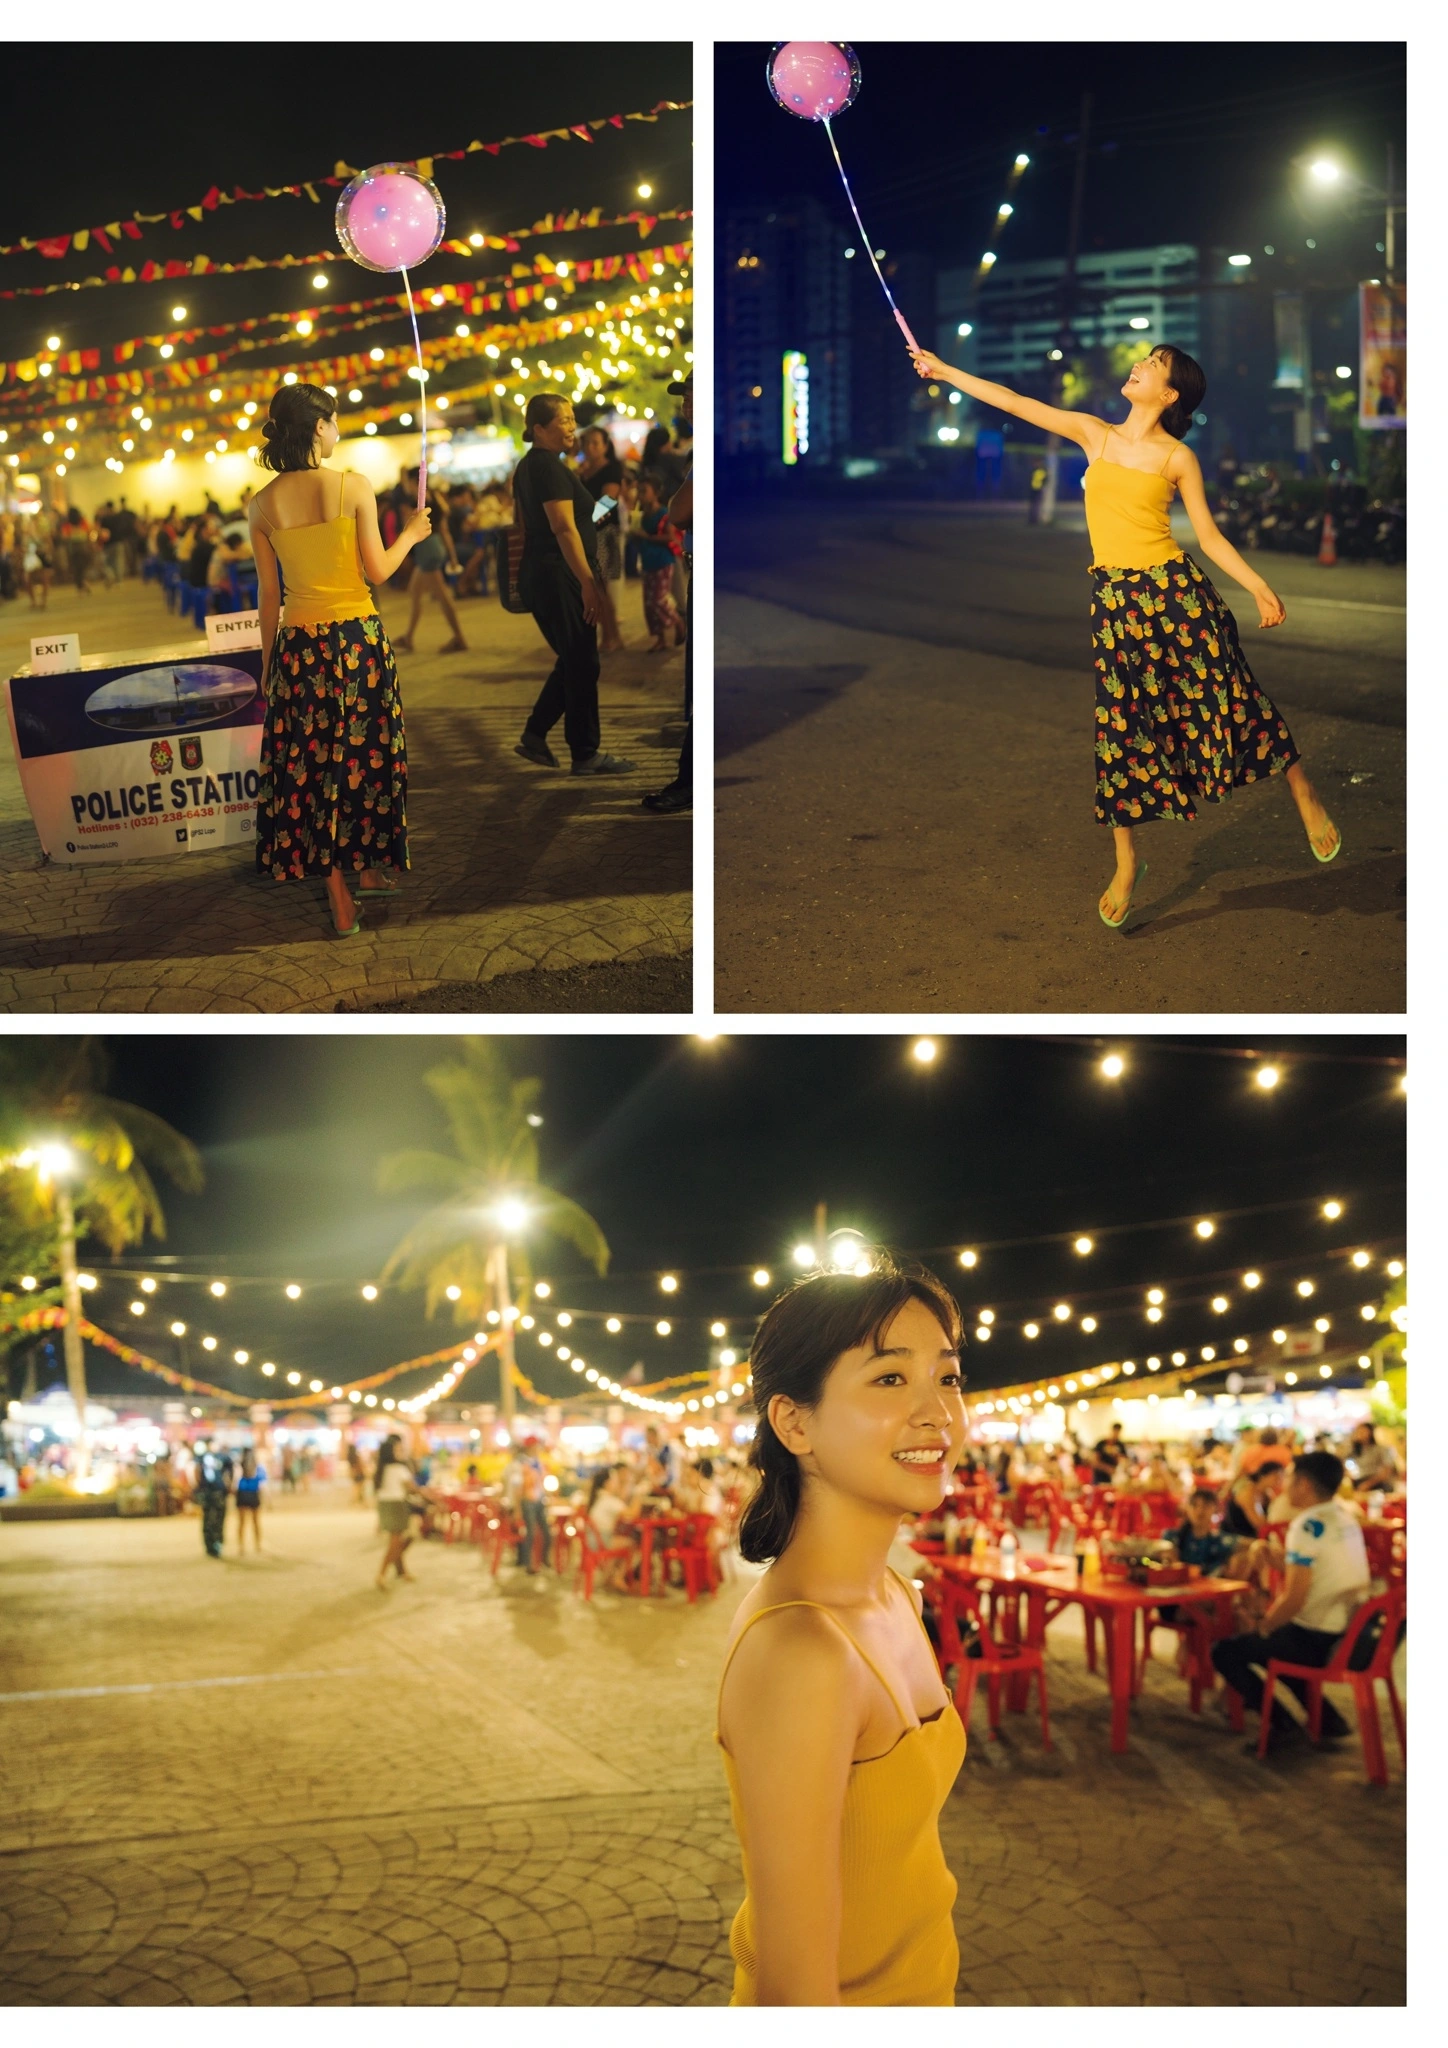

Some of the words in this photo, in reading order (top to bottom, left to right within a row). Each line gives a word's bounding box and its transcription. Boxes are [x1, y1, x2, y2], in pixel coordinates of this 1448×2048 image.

[35, 643, 68, 656] EXIT
[71, 782, 164, 823] POLICE
[78, 823, 121, 834] Hotlines
[130, 815, 159, 830] (032)
[162, 808, 215, 823] 238-6438
[217, 807, 221, 816] /
